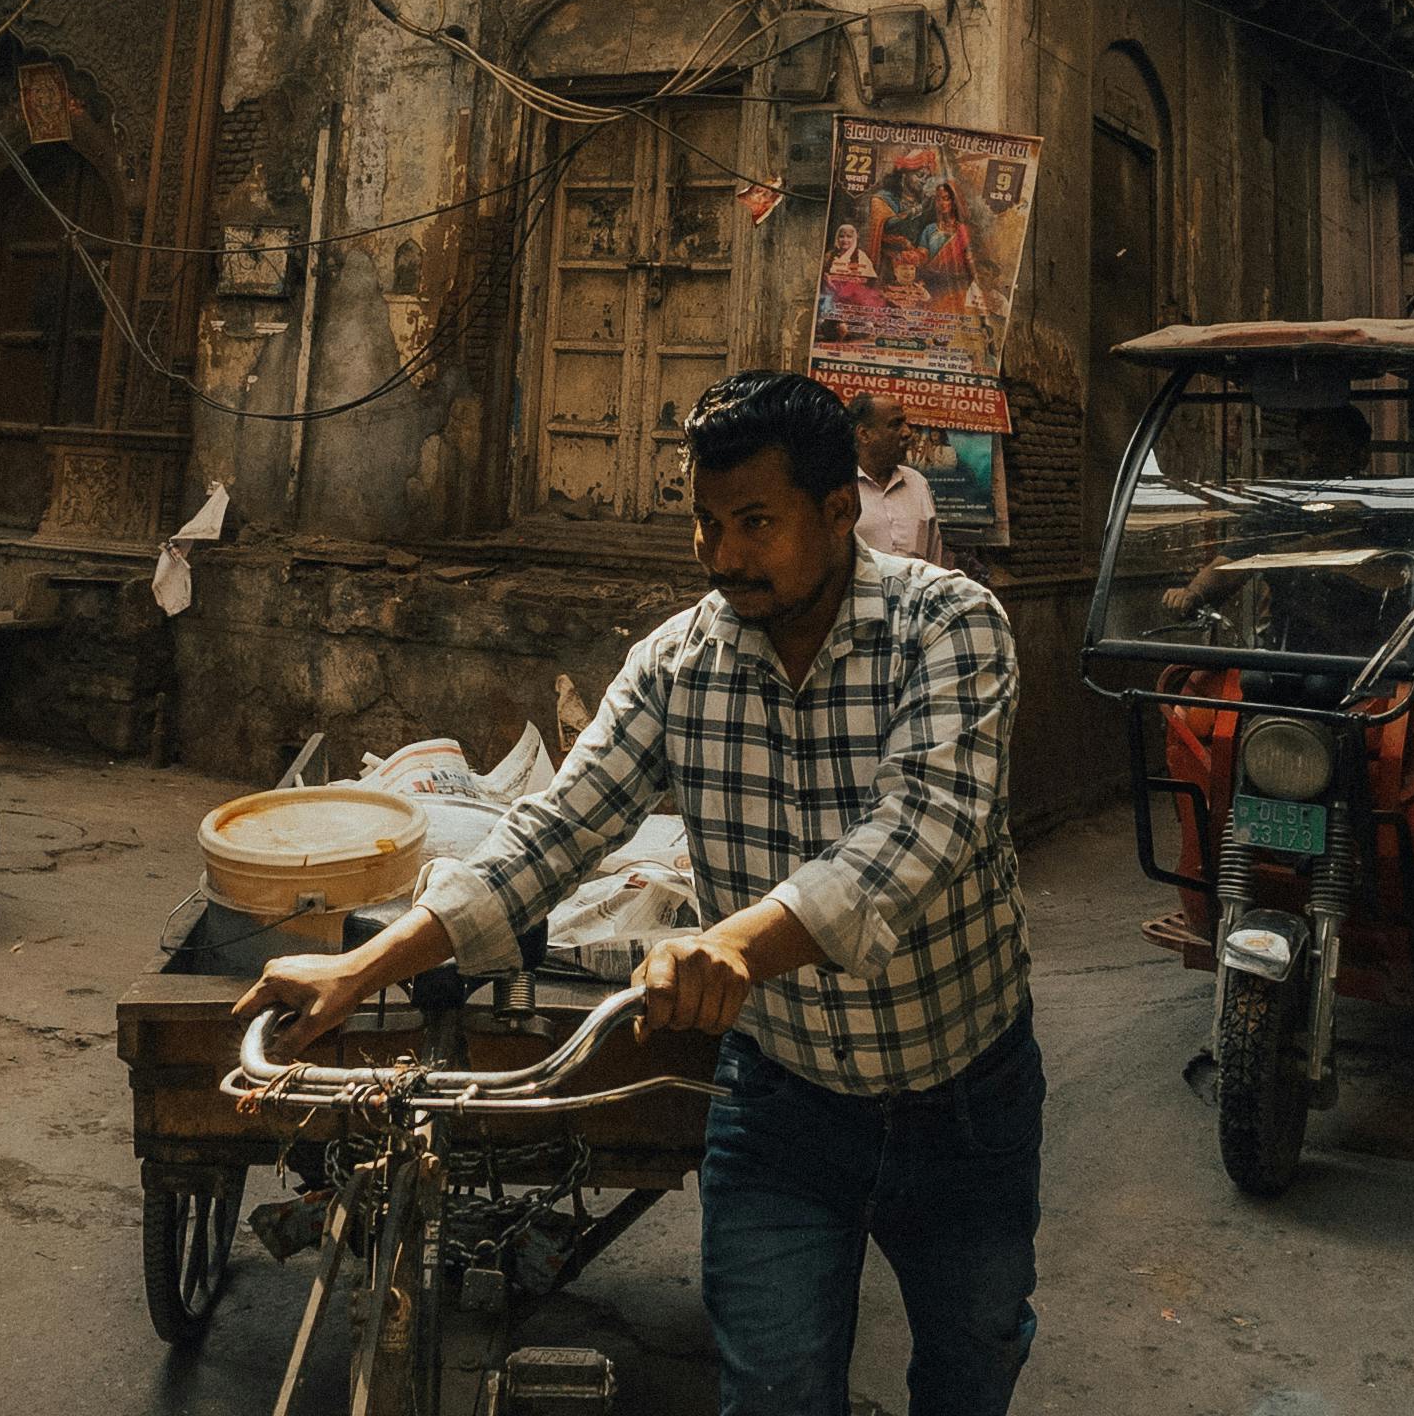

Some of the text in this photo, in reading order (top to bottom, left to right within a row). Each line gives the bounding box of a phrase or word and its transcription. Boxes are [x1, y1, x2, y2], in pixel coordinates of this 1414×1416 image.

[845, 154, 872, 174] 22
[996, 173, 1012, 191] 9
[815, 371, 893, 389] NARANG
[842, 385, 996, 414] CTRUCTIONS
